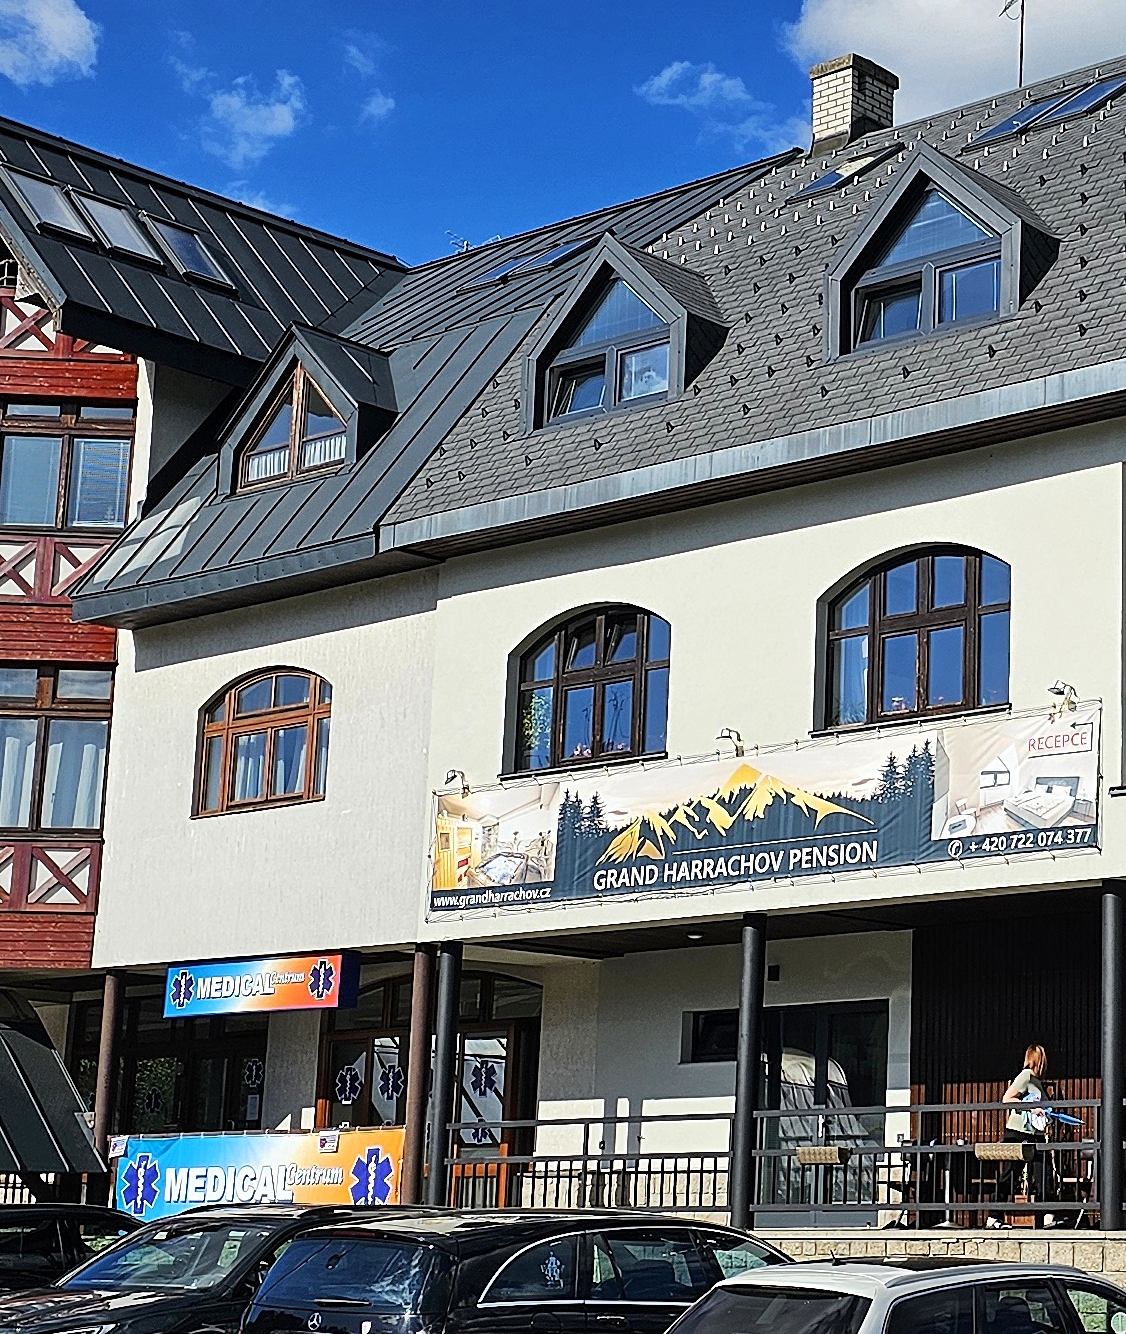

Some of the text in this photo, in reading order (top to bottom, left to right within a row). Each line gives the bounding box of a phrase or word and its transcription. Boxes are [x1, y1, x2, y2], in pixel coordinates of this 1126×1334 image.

[1028, 731, 1088, 752] RECEPCE
[969, 828, 1092, 853] + 420 722 074 377
[593, 840, 879, 891] GRAND HARRACHOV PENSION
[433, 887, 551, 908] www.grandharrachov.cz
[196, 970, 306, 1000] MEDICAL Centrum
[163, 1162, 344, 1204] MEDICAL Centrum
